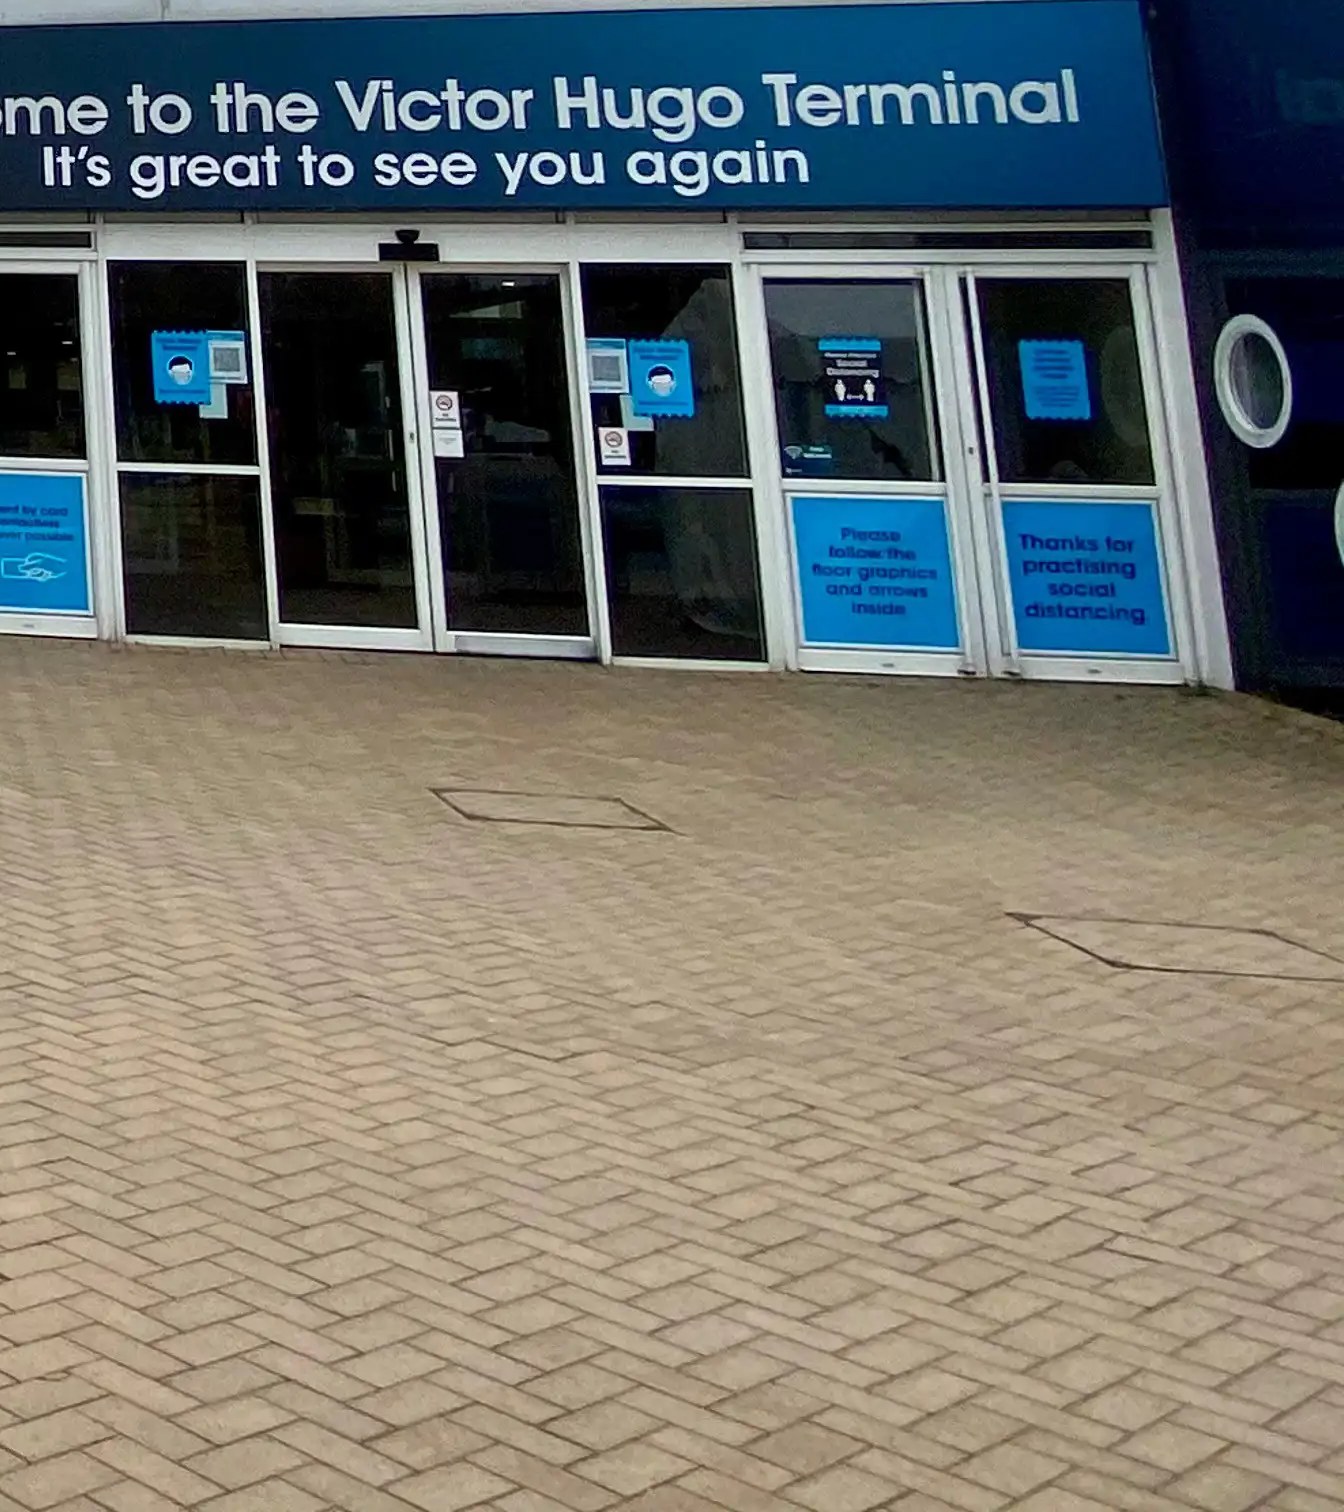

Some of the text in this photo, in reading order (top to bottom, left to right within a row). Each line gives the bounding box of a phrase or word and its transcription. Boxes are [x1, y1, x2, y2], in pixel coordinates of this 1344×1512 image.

[127, 83, 192, 135] to
[210, 82, 319, 134] the
[334, 78, 534, 132] Victor
[555, 76, 744, 143] Hugo
[760, 68, 1080, 128] Terminal
[43, 140, 810, 199] It's great to see you again
[840, 527, 901, 542] Please
[1018, 533, 1135, 553] Thanks for
[858, 564, 938, 582] graphics
[1022, 558, 1137, 579] practising
[825, 582, 863, 597] and
[1047, 581, 1117, 599] social
[851, 600, 907, 616] inside
[1023, 602, 1147, 626] distancing
